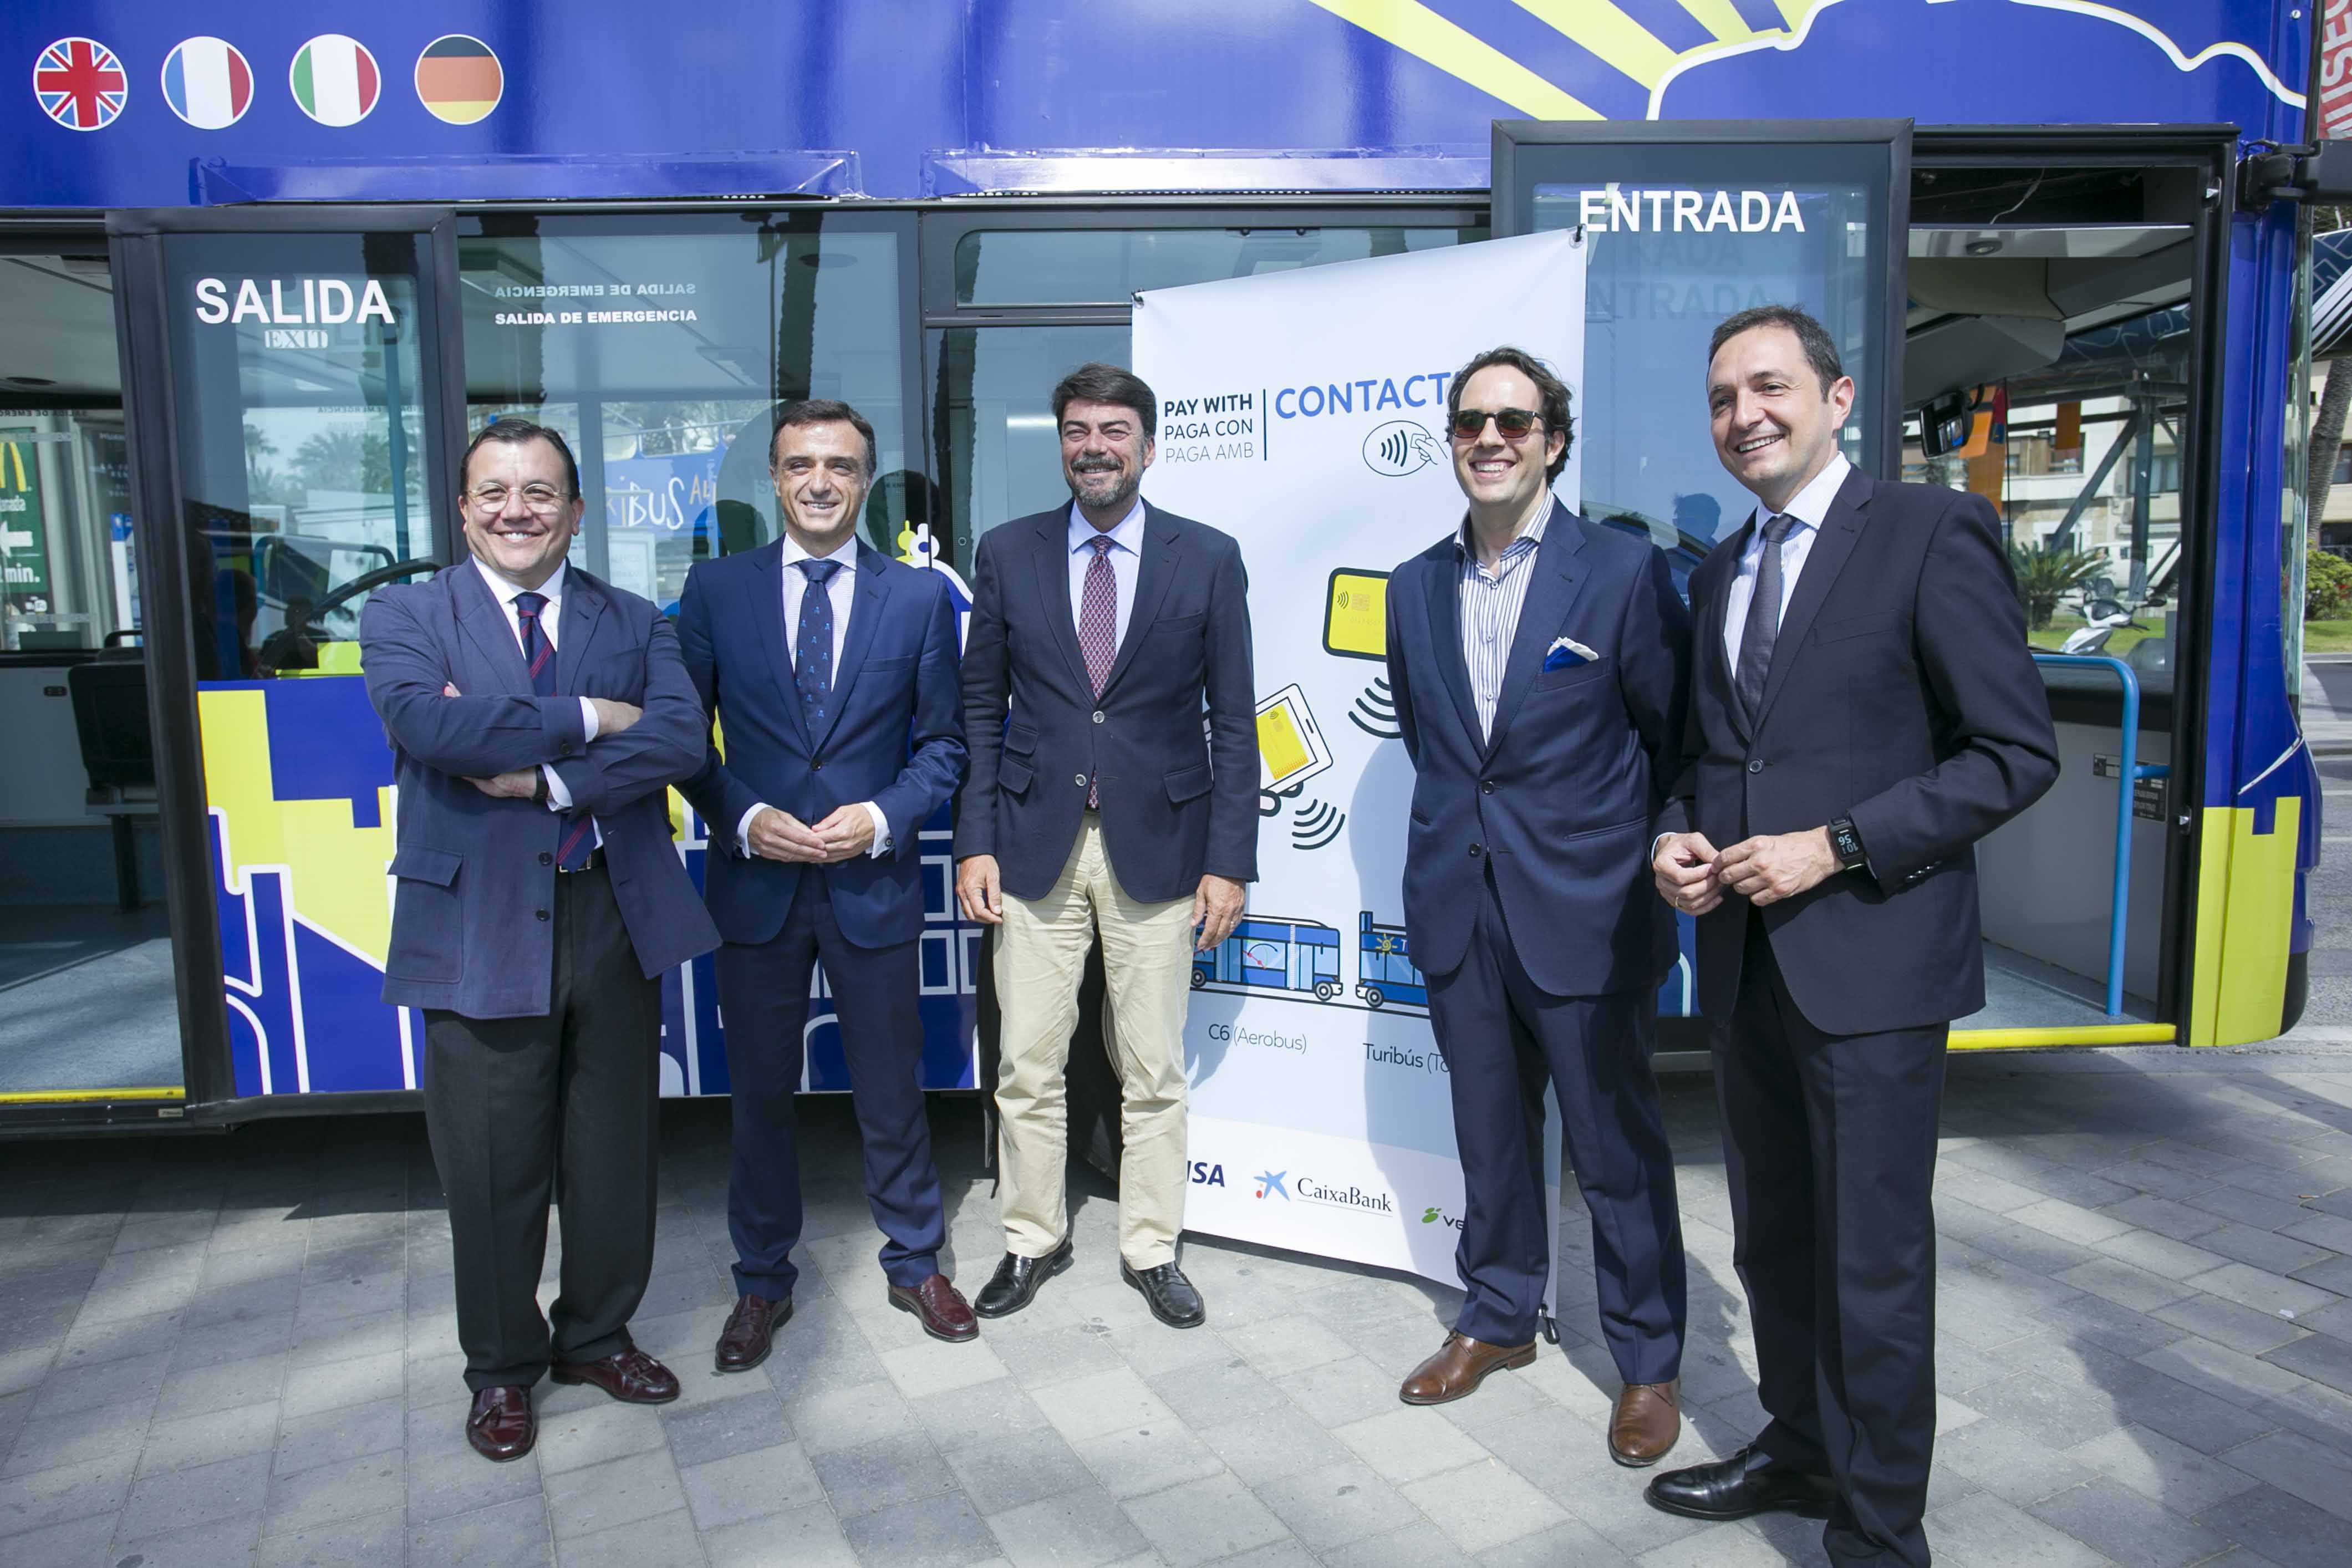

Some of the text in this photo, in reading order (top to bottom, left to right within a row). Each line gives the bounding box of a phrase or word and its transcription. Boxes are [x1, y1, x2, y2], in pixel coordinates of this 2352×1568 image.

[1580, 190, 1805, 232] ENTRADA
[196, 278, 395, 324] SALIDA
[495, 310, 697, 325] SALIDA DE EMERGENCIA
[265, 330, 328, 349] EXIT
[1164, 393, 1253, 418] PAY WITH
[1275, 371, 1458, 419] CONTACT
[1165, 418, 1253, 441] PAGA CON
[1166, 442, 1254, 464] PAGA AMB
[1208, 1024, 1307, 1055] C6 (Aerobus)
[1362, 1042, 1424, 1068] Turibús
[1297, 1177, 1392, 1213] CaixaBank
